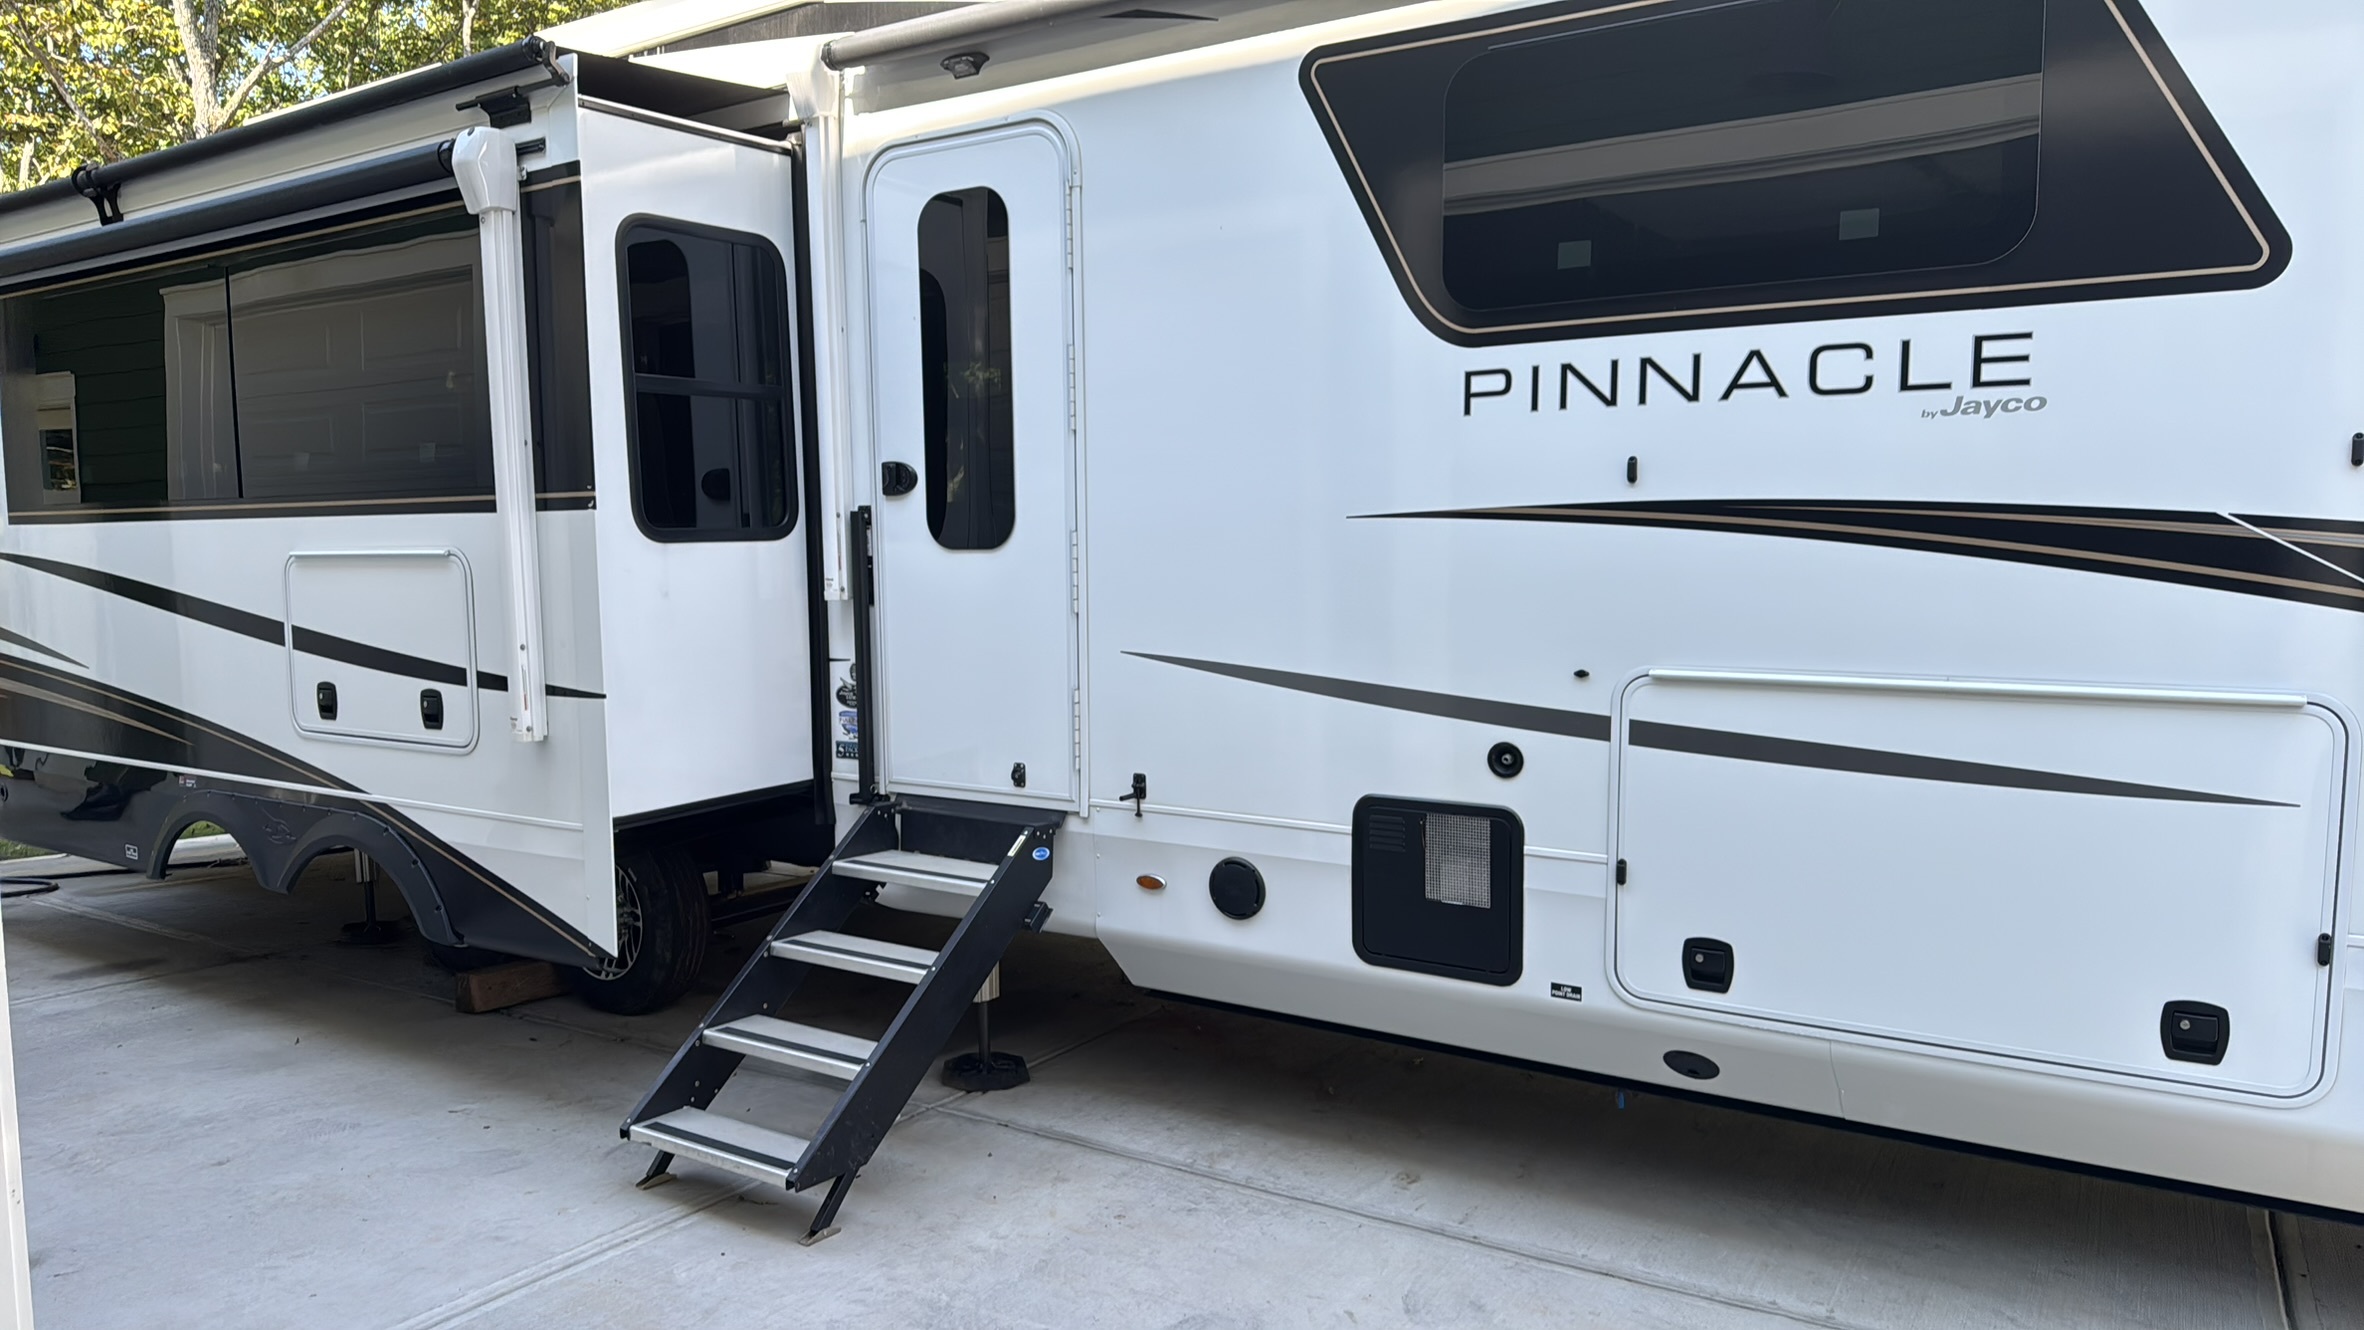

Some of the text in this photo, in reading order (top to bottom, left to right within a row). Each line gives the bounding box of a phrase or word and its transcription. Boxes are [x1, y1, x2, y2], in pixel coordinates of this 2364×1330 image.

[1463, 331, 2034, 417] PINNACLE
[1920, 395, 2048, 419] by Jayco
[1552, 989, 1566, 997] POINT
